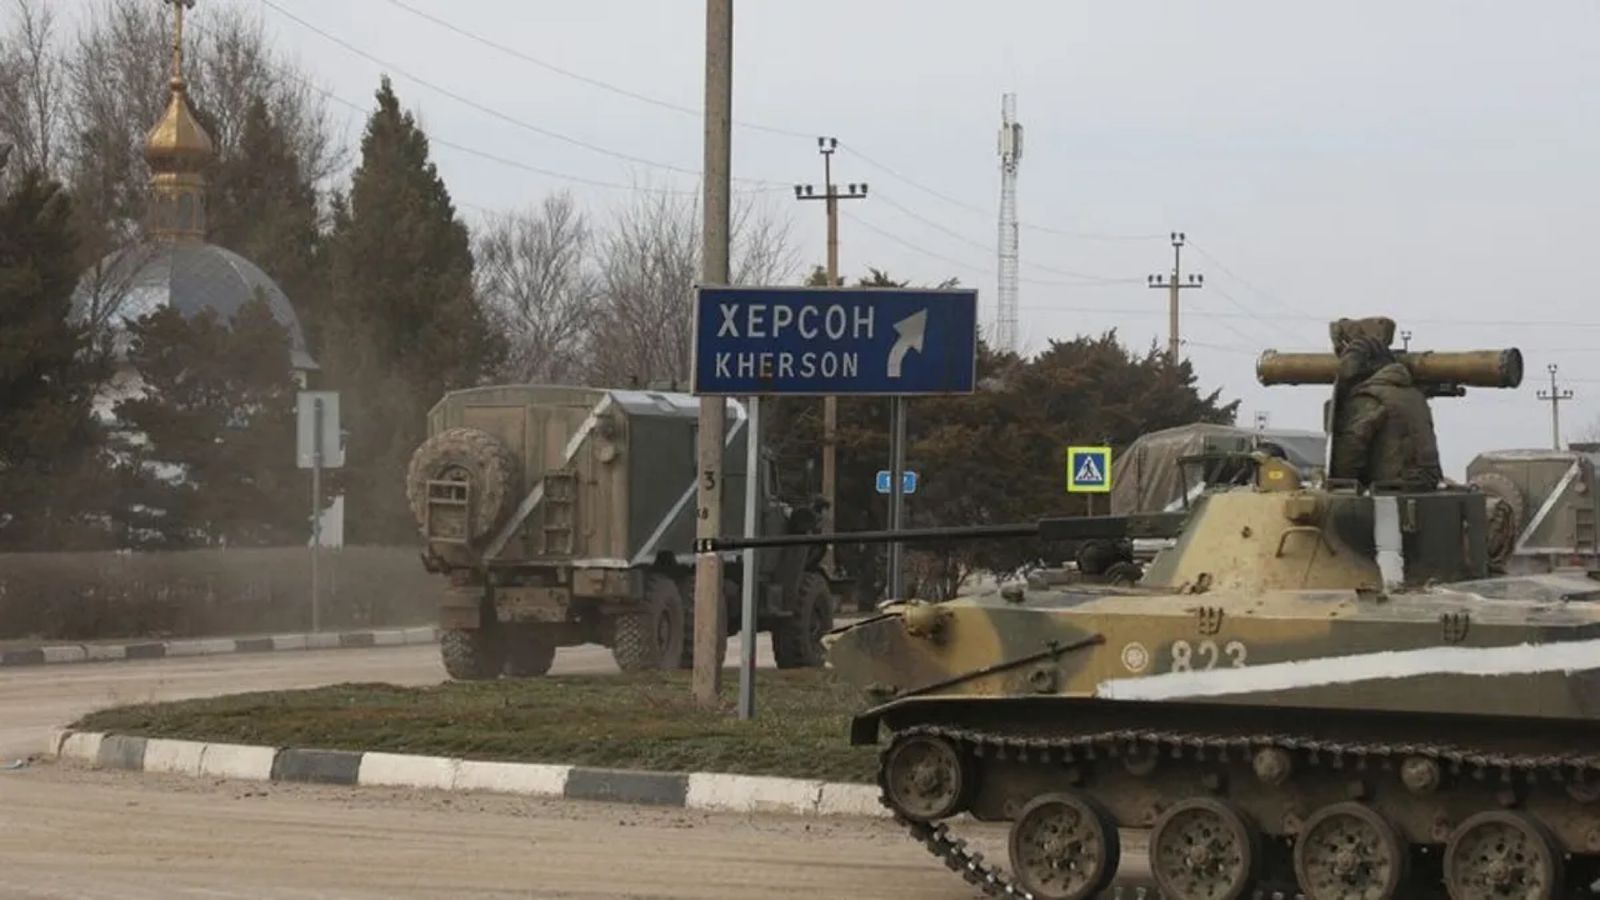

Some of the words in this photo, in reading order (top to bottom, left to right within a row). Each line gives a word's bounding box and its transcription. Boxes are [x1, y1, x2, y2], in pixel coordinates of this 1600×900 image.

[717, 303, 876, 339] ХЕРСОН
[715, 352, 858, 378] KHERSON
[1171, 640, 1248, 672] 823
